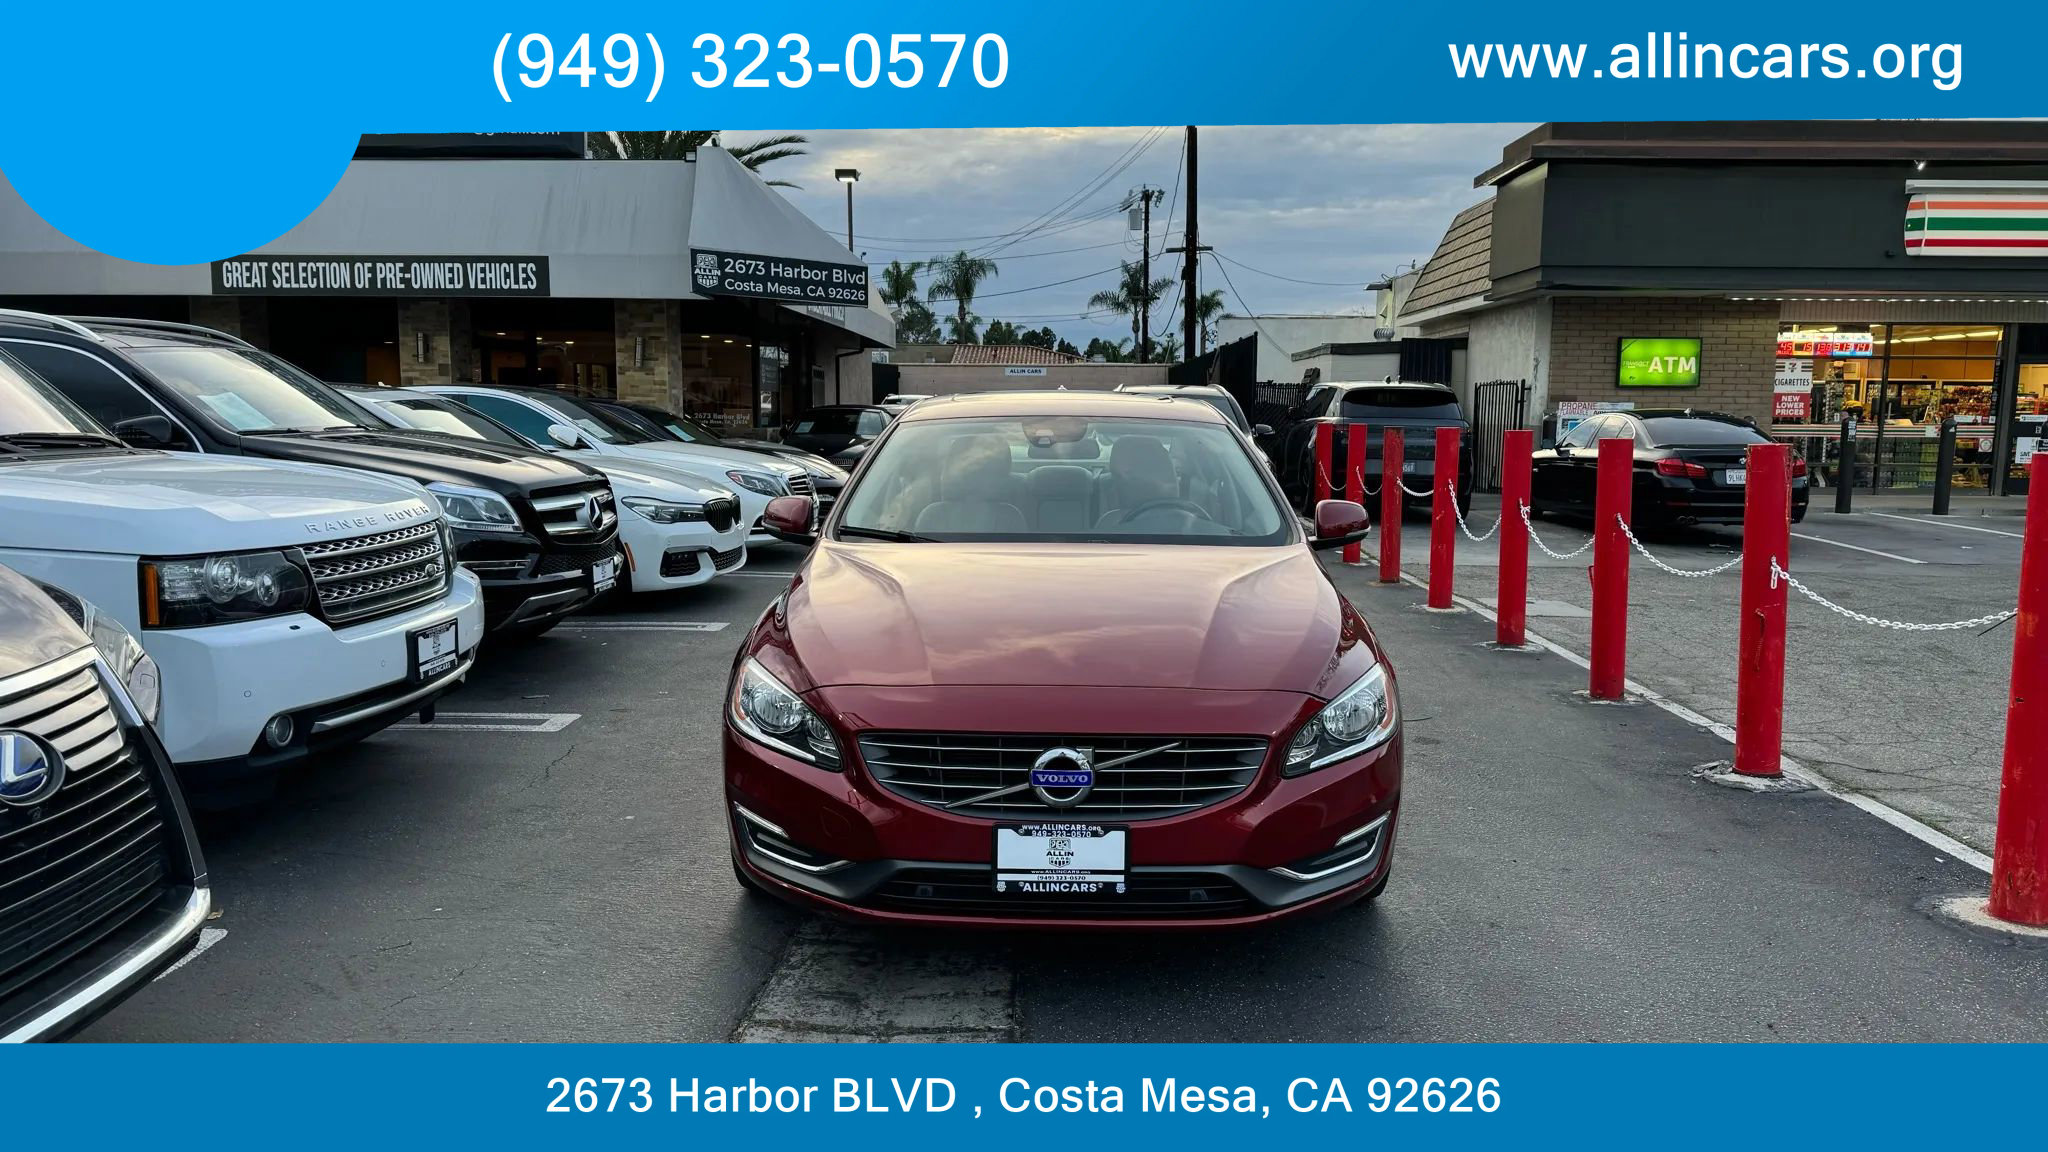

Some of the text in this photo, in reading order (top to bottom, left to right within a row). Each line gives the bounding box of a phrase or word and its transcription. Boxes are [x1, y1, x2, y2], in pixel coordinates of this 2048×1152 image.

[223, 261, 537, 290] GREAT SELECTION OF PRE-OWNED VEHICLES
[694, 268, 721, 276] ALLIN
[724, 258, 866, 285] 2673 Harbor Blvd
[724, 278, 866, 301] Costa Mesa, CA 92626
[1648, 356, 1697, 374] ATM
[1774, 378, 1811, 386] CIGARETTES
[1561, 402, 1598, 410] PROPANE
[304, 504, 431, 535] RANGE ROVER
[1036, 774, 1089, 783] VOLVO
[1031, 830, 1092, 838] 949-323-0570
[1022, 882, 1098, 893] ALLINCARS
